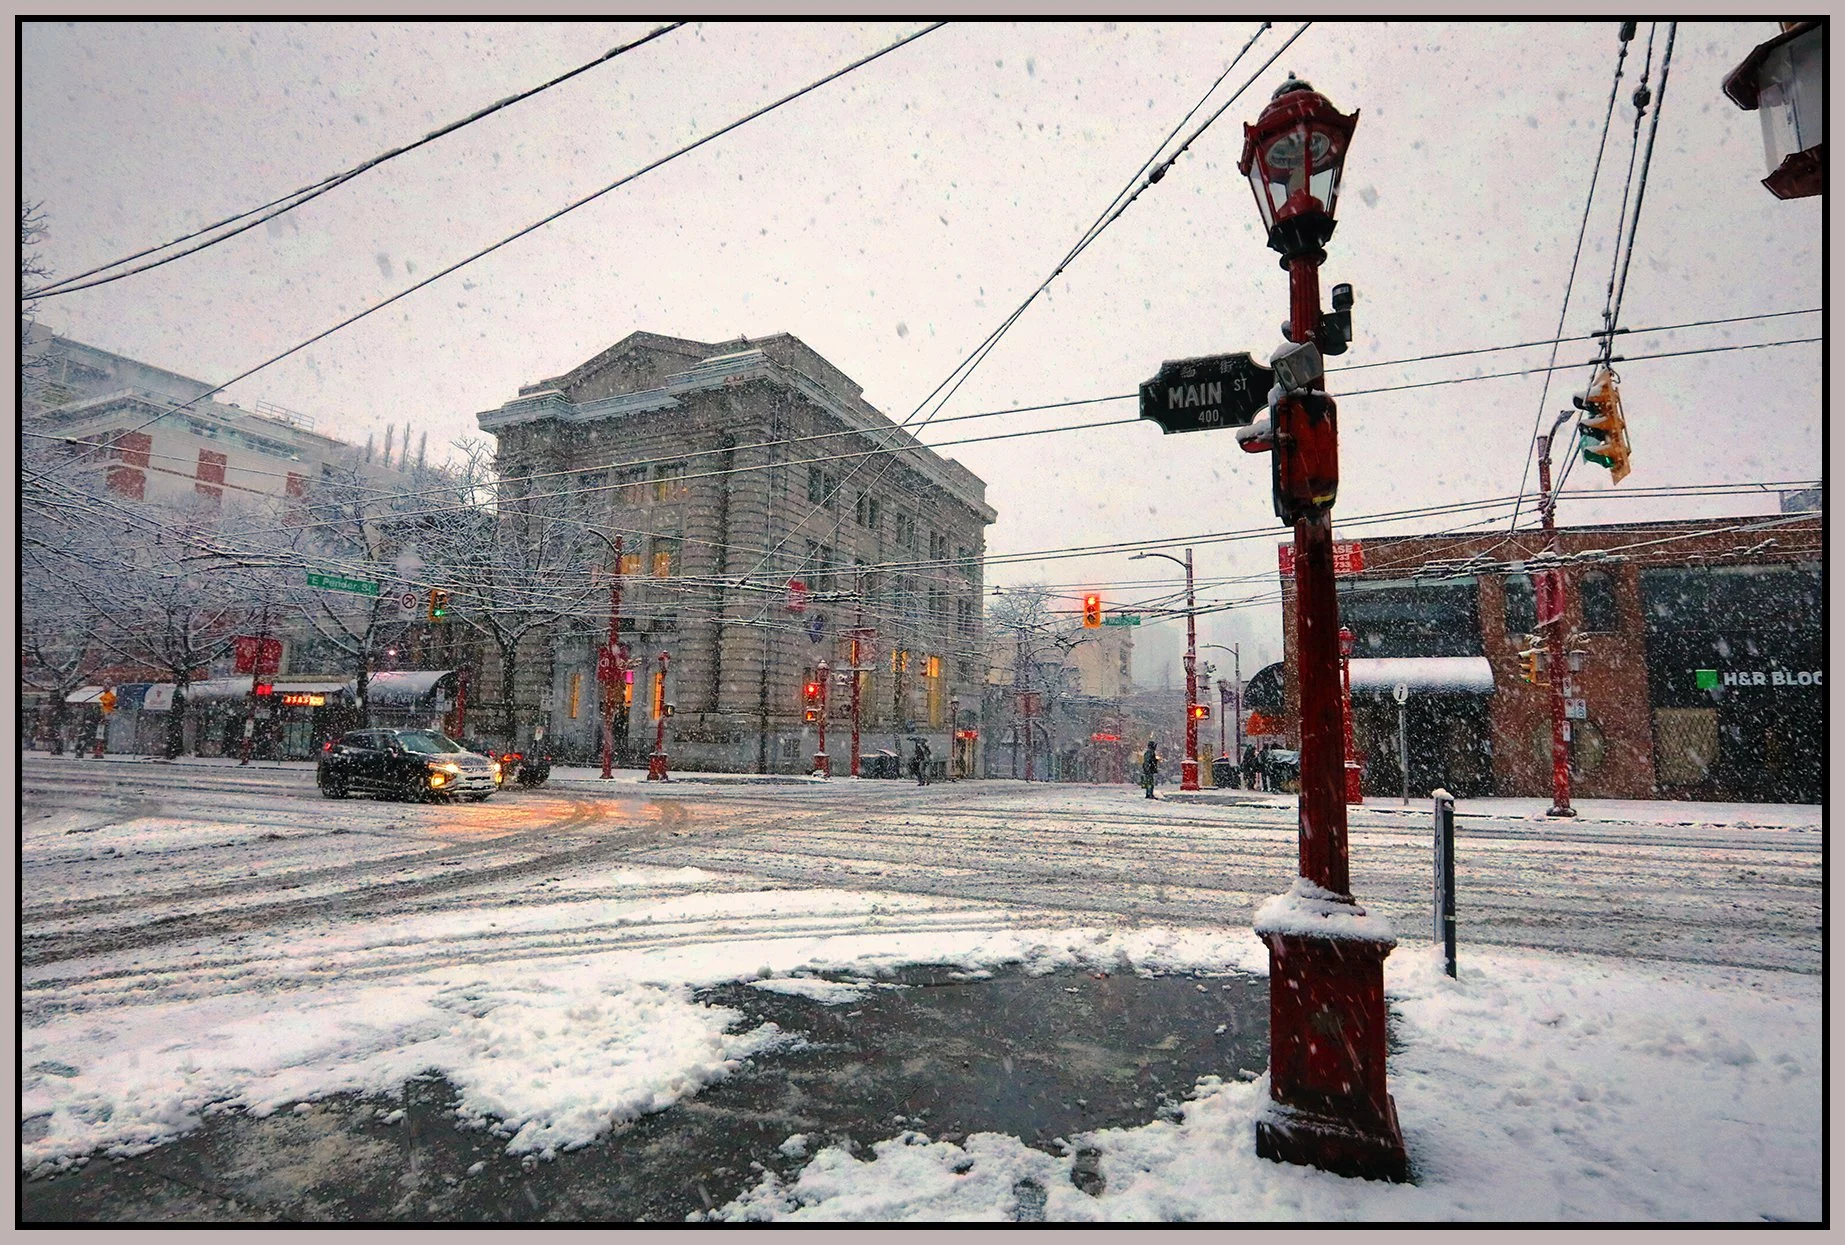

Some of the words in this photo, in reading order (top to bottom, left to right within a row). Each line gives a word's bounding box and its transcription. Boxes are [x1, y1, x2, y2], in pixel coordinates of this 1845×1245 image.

[1168, 381, 1222, 409] MAIN
[1234, 377, 1248, 392] ST
[1198, 409, 1219, 423] 400
[312, 576, 319, 585] E
[322, 577, 358, 590] Pender
[1723, 671, 1767, 686] H&R
